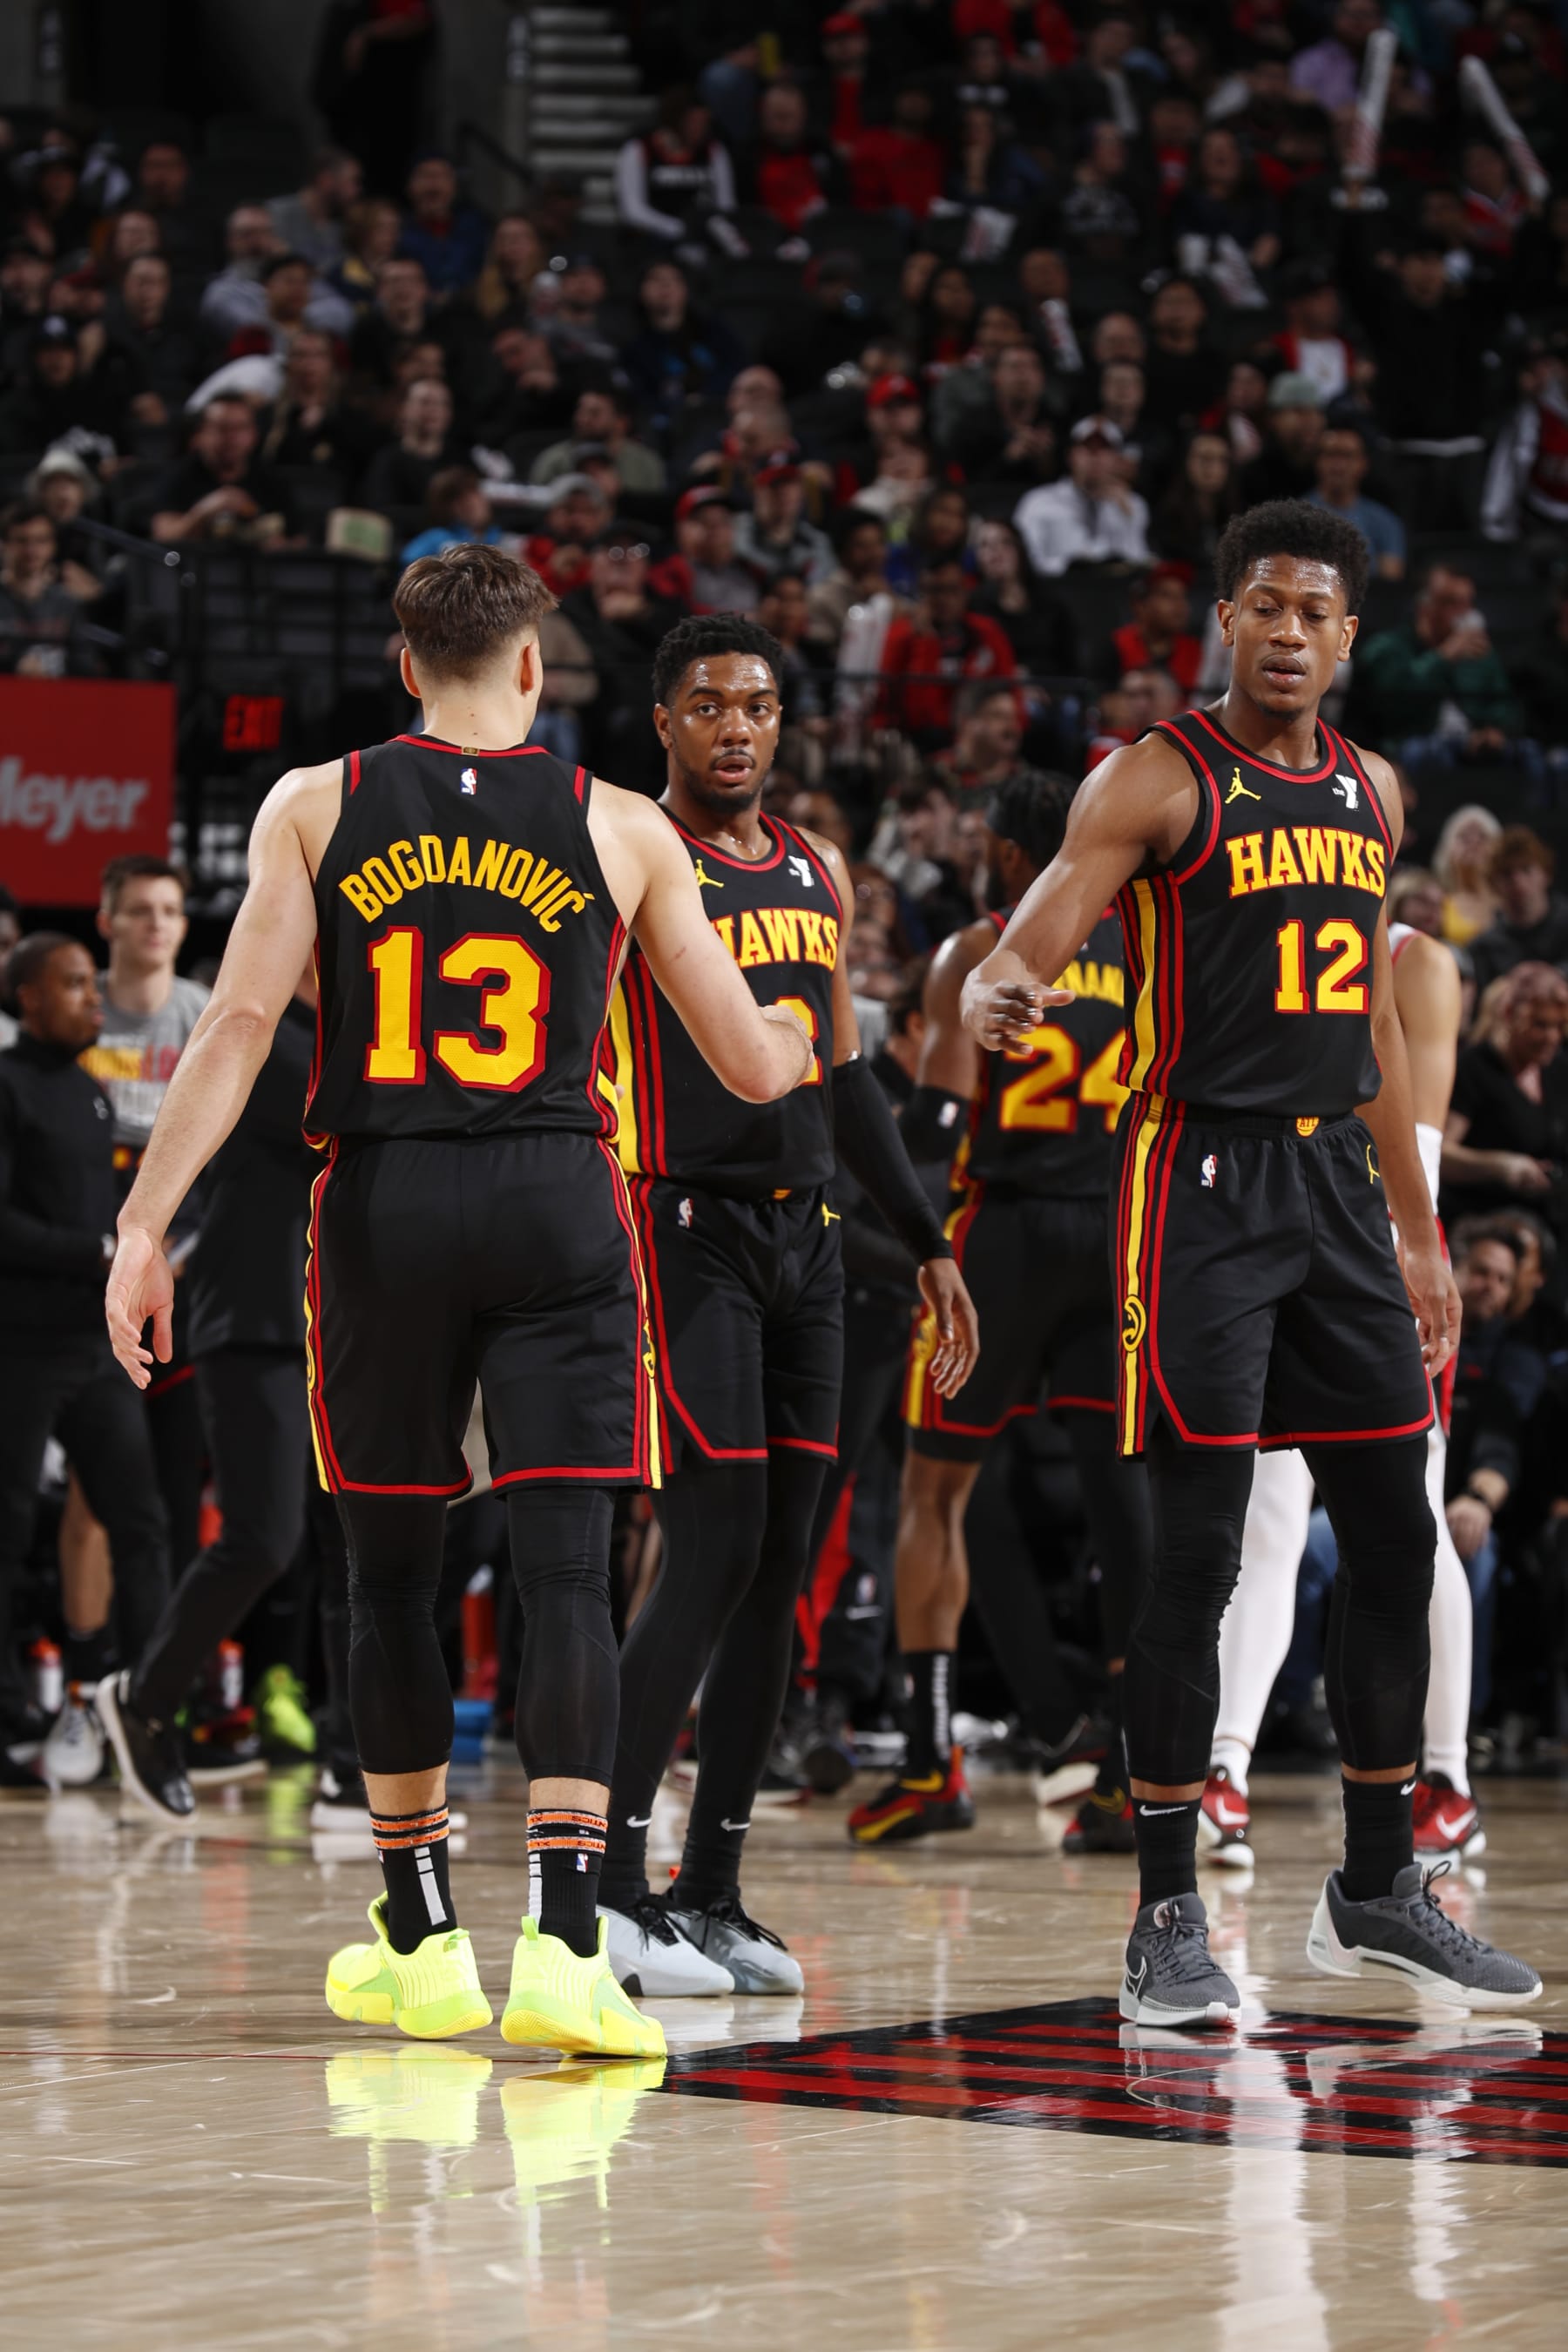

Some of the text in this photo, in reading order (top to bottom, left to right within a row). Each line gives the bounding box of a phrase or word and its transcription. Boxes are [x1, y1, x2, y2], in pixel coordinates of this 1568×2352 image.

[224, 693, 284, 752] EXIT
[1225, 826, 1387, 899] HAWKS
[363, 925, 552, 1093] 13
[1274, 918, 1370, 1015] 12
[999, 1022, 1131, 1133] 24
